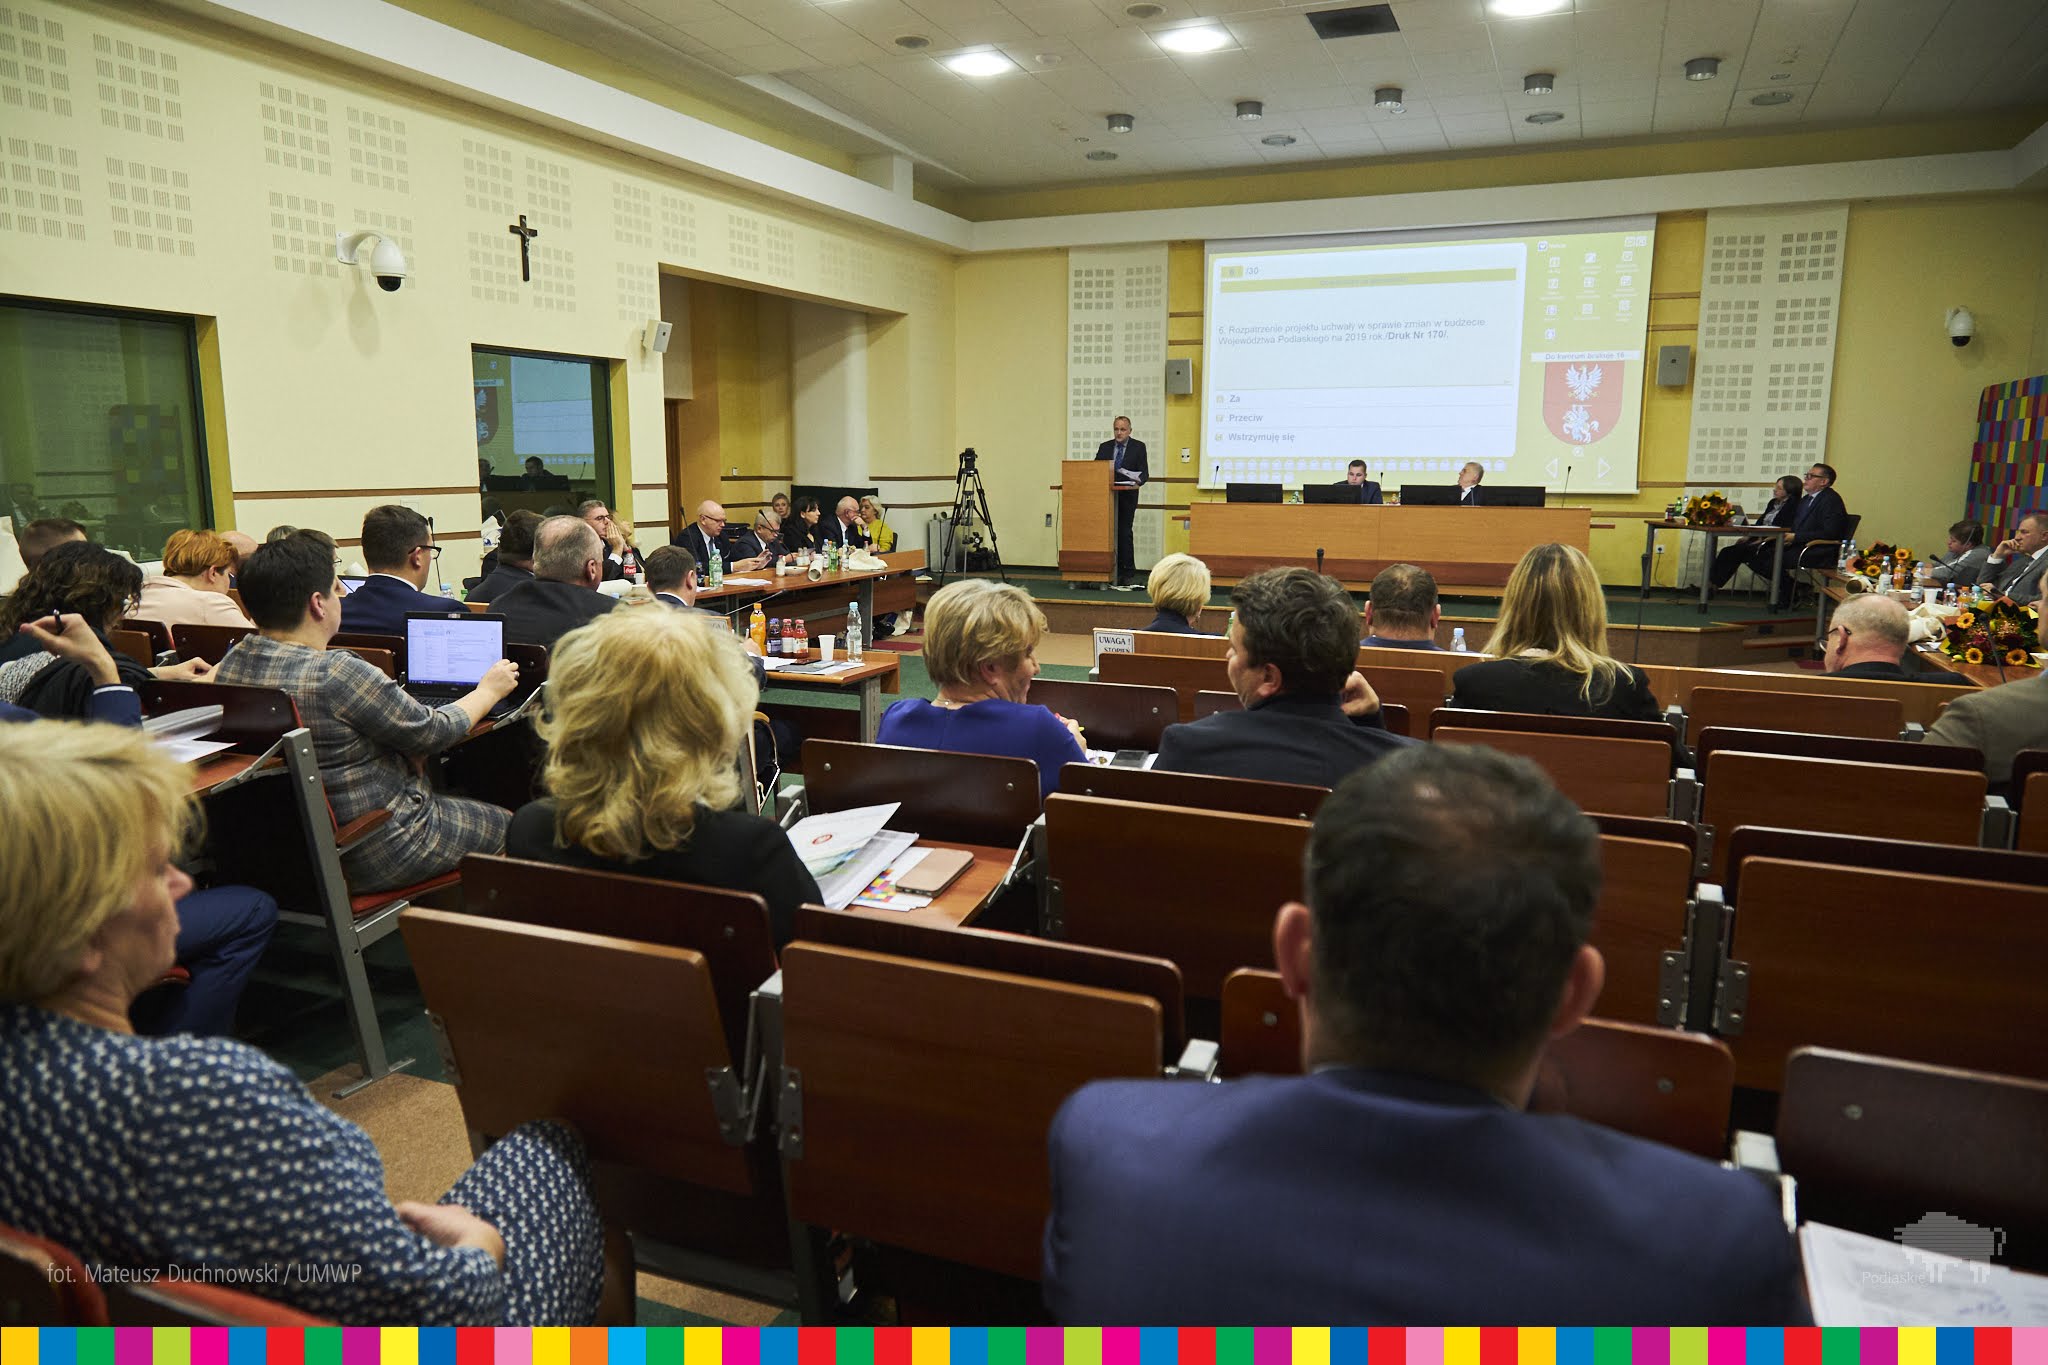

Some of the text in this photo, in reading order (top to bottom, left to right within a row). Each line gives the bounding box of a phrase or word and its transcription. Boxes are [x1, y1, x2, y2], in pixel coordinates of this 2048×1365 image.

[1246, 266, 1259, 275] /30
[1229, 325, 1282, 336] Rozpatrzenie
[1285, 323, 1318, 335] projektu
[1321, 322, 1355, 332] uchwały
[1368, 321, 1401, 330] sprawie
[1404, 320, 1432, 328] zmian
[1218, 336, 1275, 346] Województwa
[1278, 334, 1329, 344] Podlaskiego
[1346, 333, 1366, 341] 2019
[1386, 331, 1410, 340] /Druk
[1413, 331, 1424, 339] Nr
[1229, 394, 1241, 403] Za
[1229, 414, 1263, 422] Przeciw
[1228, 432, 1295, 443] Wstrzymuję się
[1099, 636, 1126, 645] UWAGA
